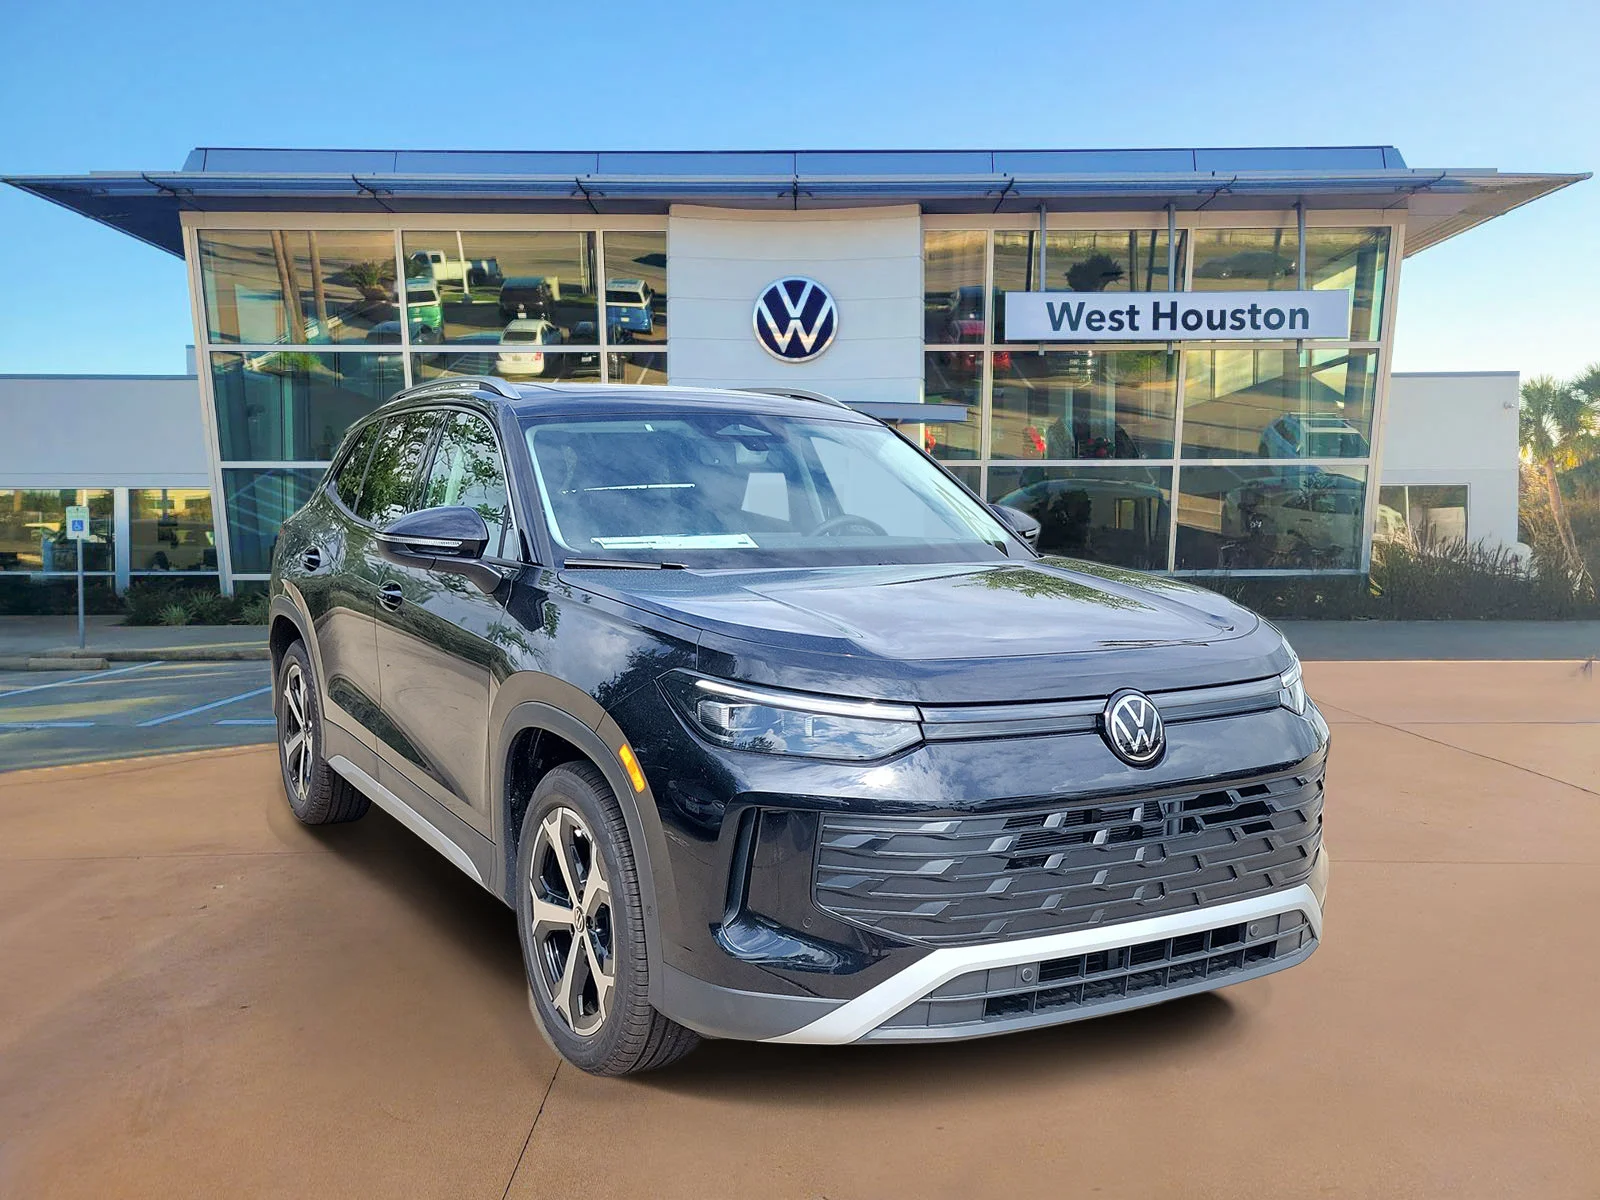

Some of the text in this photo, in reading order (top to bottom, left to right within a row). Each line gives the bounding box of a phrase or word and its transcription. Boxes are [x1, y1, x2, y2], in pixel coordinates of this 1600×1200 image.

[755, 278, 836, 356] VW
[1045, 301, 1310, 332] West Houston
[1112, 697, 1160, 754] VW
